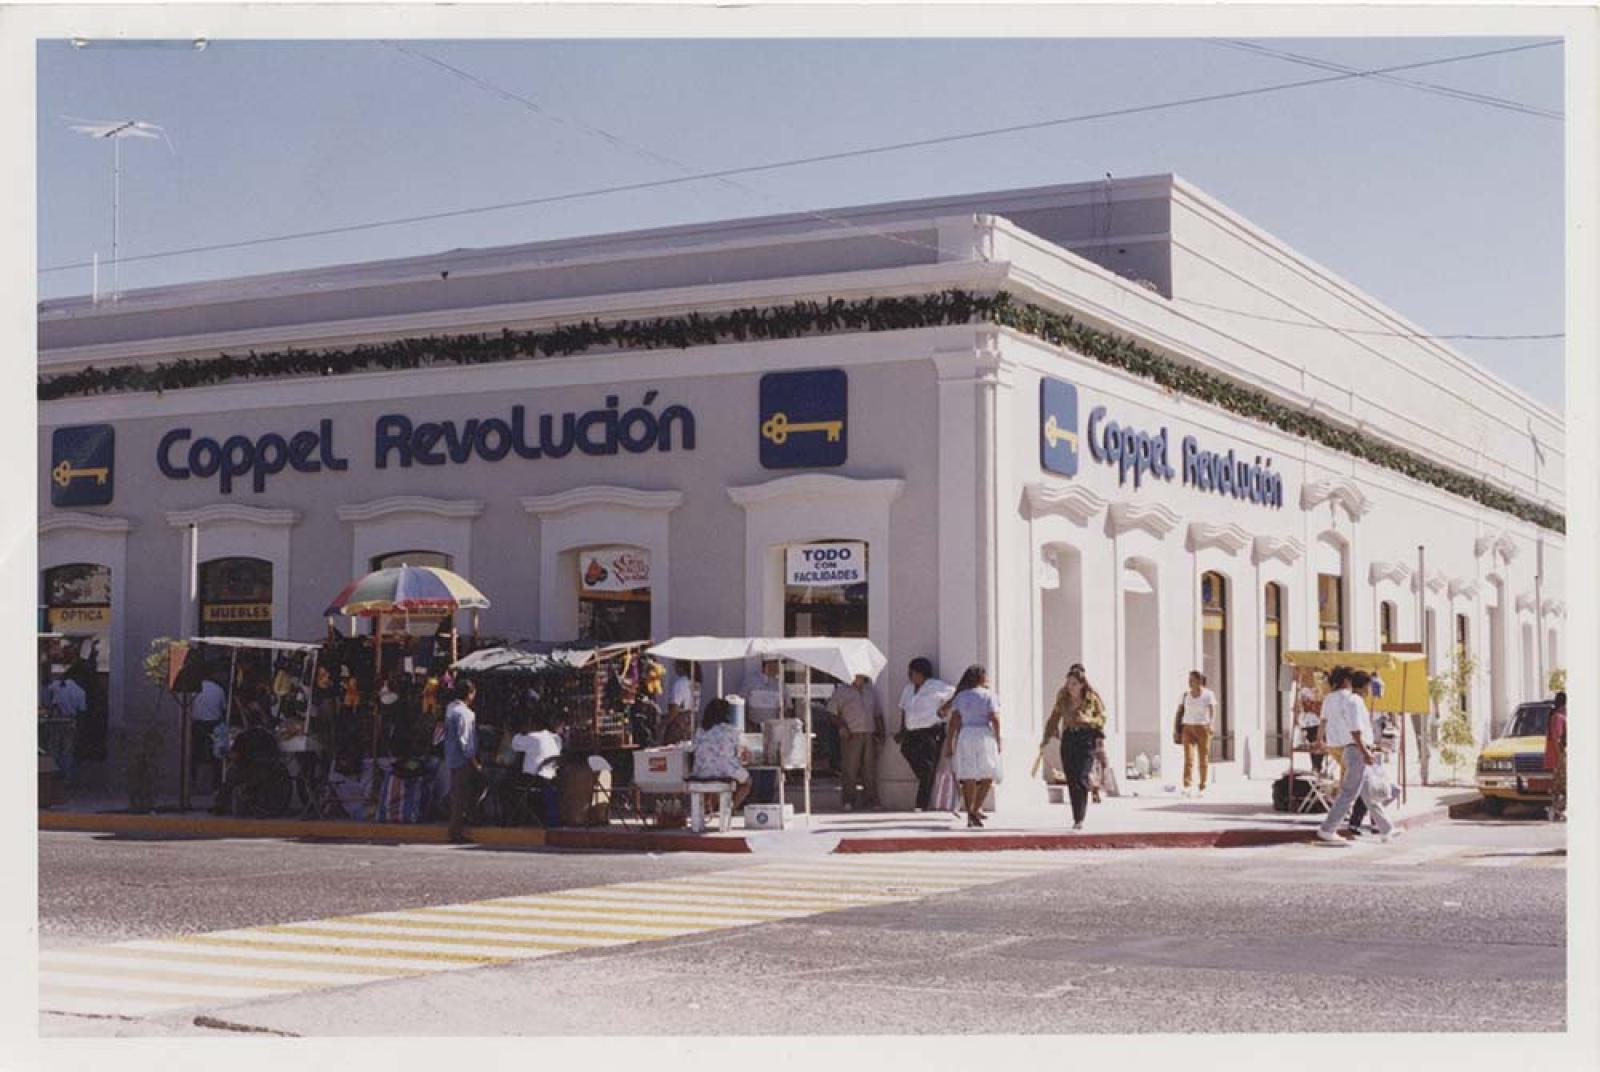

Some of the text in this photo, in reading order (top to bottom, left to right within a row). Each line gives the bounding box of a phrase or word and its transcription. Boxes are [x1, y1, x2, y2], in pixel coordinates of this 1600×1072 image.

[156, 389, 696, 494] Coppel Revolución
[1087, 405, 1283, 511] Coppel Revolución
[802, 548, 851, 561] TODO
[814, 561, 837, 570] CON
[793, 569, 859, 582] FACILIDADES
[60, 609, 104, 622] OPTICA
[210, 606, 270, 618] MUEBLES
